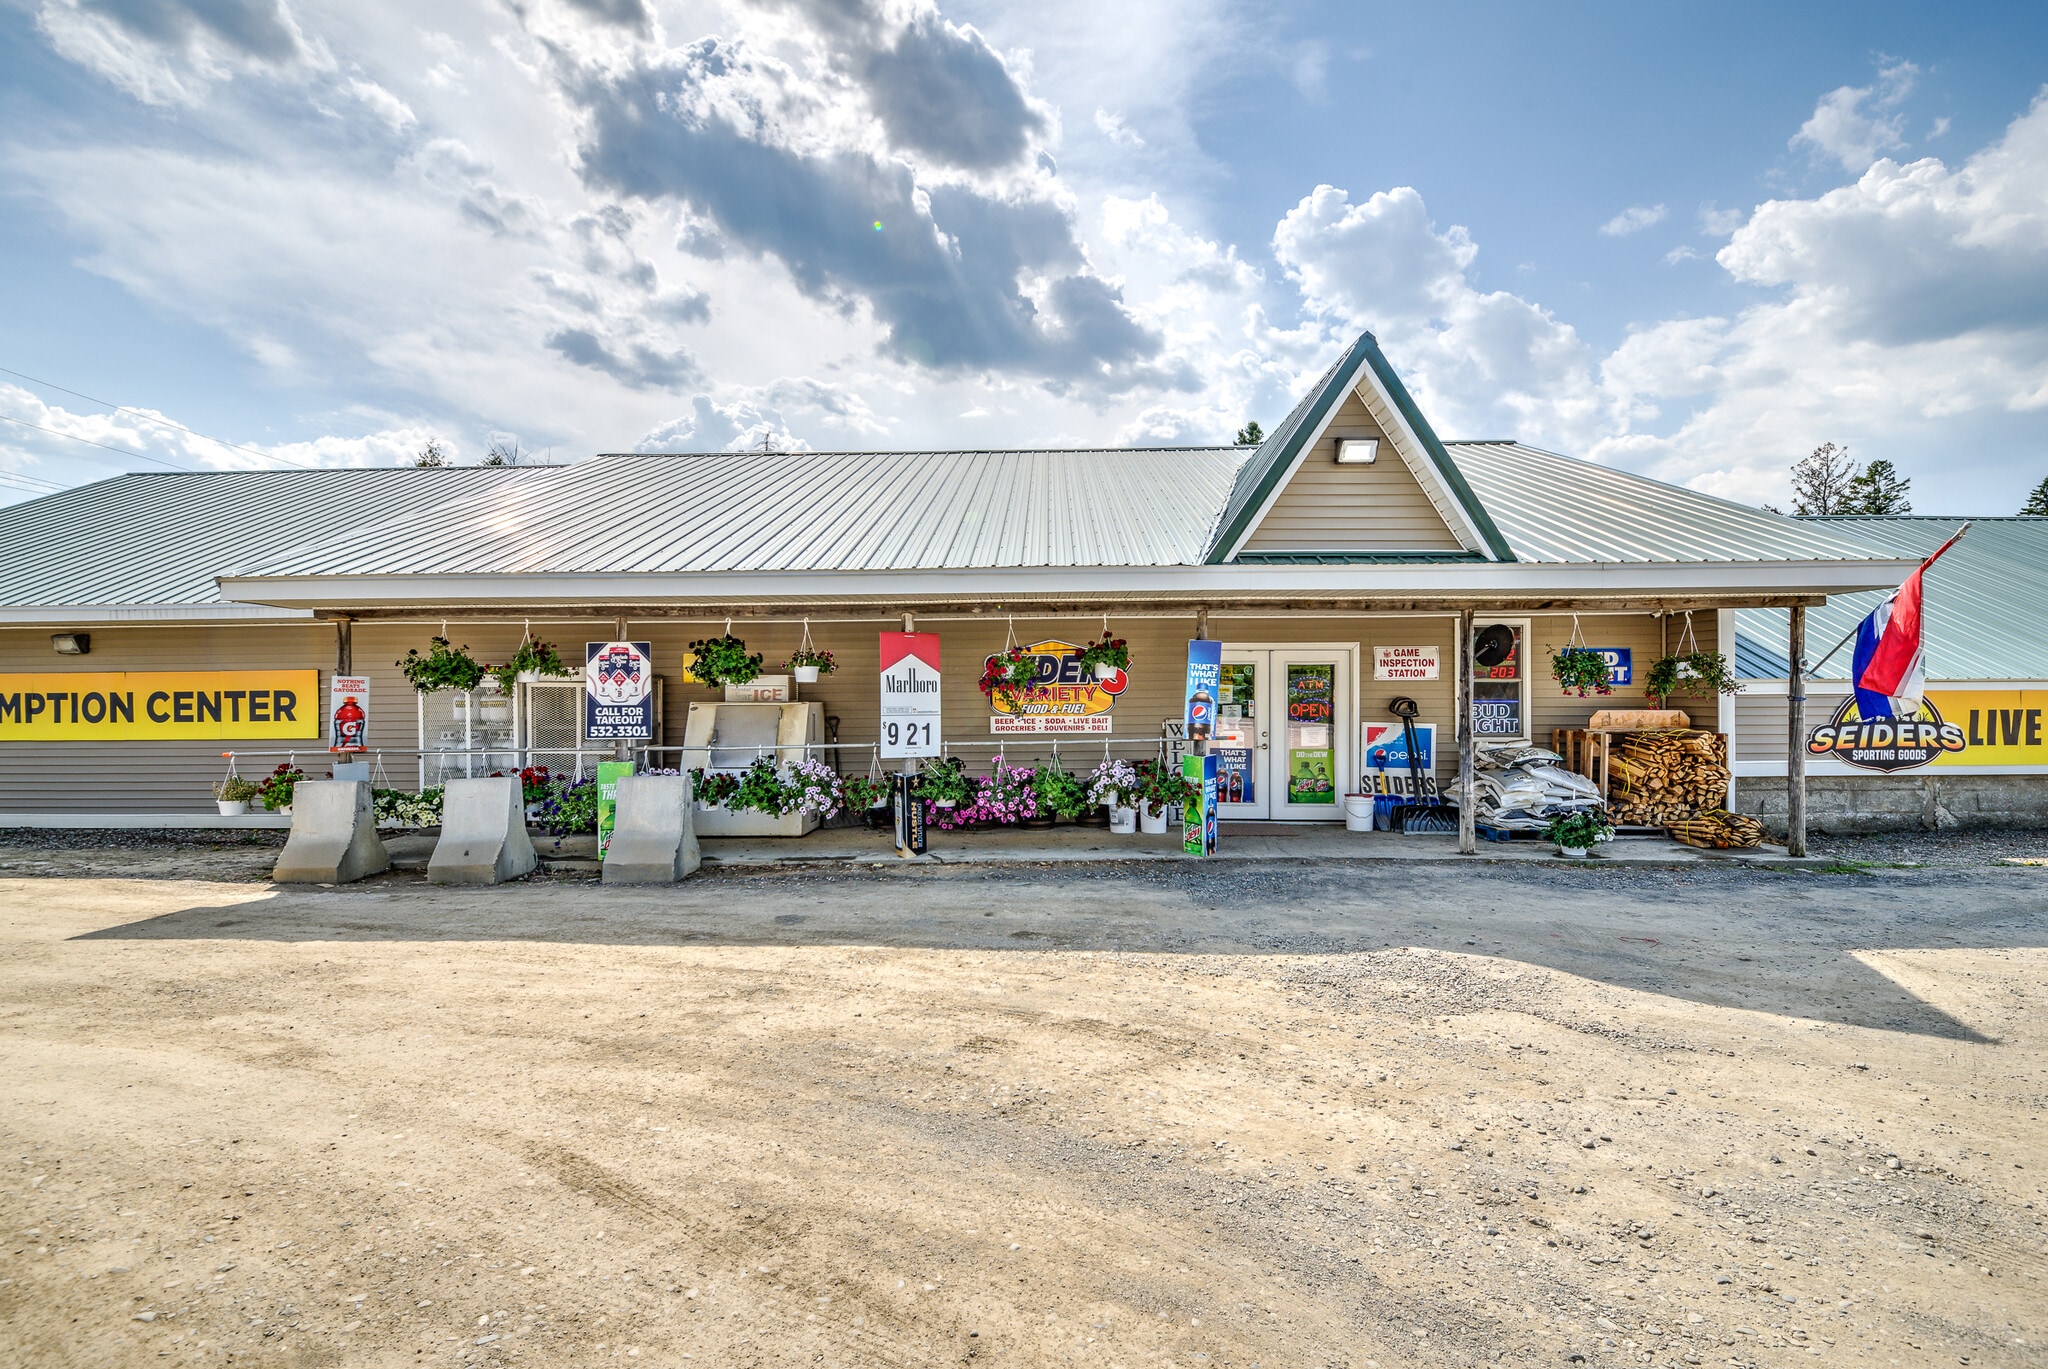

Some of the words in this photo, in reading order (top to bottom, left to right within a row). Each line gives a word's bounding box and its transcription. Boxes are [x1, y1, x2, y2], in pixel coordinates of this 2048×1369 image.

[1394, 648, 1420, 657] GAME
[1190, 663, 1218, 671] THAT'S
[1380, 658, 1434, 668] INSPECTION
[1387, 669, 1426, 678] STATION
[1490, 667, 1515, 678] 203
[886, 668, 938, 693] Marlboro
[1194, 678, 1217, 687] LIKE
[1298, 680, 1324, 690] ATM
[754, 688, 783, 701] ICE
[1011, 686, 1096, 701] VARIETY
[0, 691, 134, 724] MPTION
[146, 690, 298, 723] CENTER
[595, 707, 620, 716] CALL
[622, 707, 644, 716] FOR
[1021, 704, 1048, 714] FOOD
[1050, 704, 1059, 714] &
[1061, 704, 1086, 714] FUEL
[1290, 704, 1330, 717] OPEN
[1473, 704, 1510, 718] BUD
[595, 716, 644, 725] TAKEOUT
[590, 726, 648, 737] 532-3301
[1969, 708, 2042, 746] LIVE
[1810, 723, 1964, 752] SEIDERS
[1852, 750, 1896, 761] SPORTING
[1898, 750, 1927, 760] GOODS
